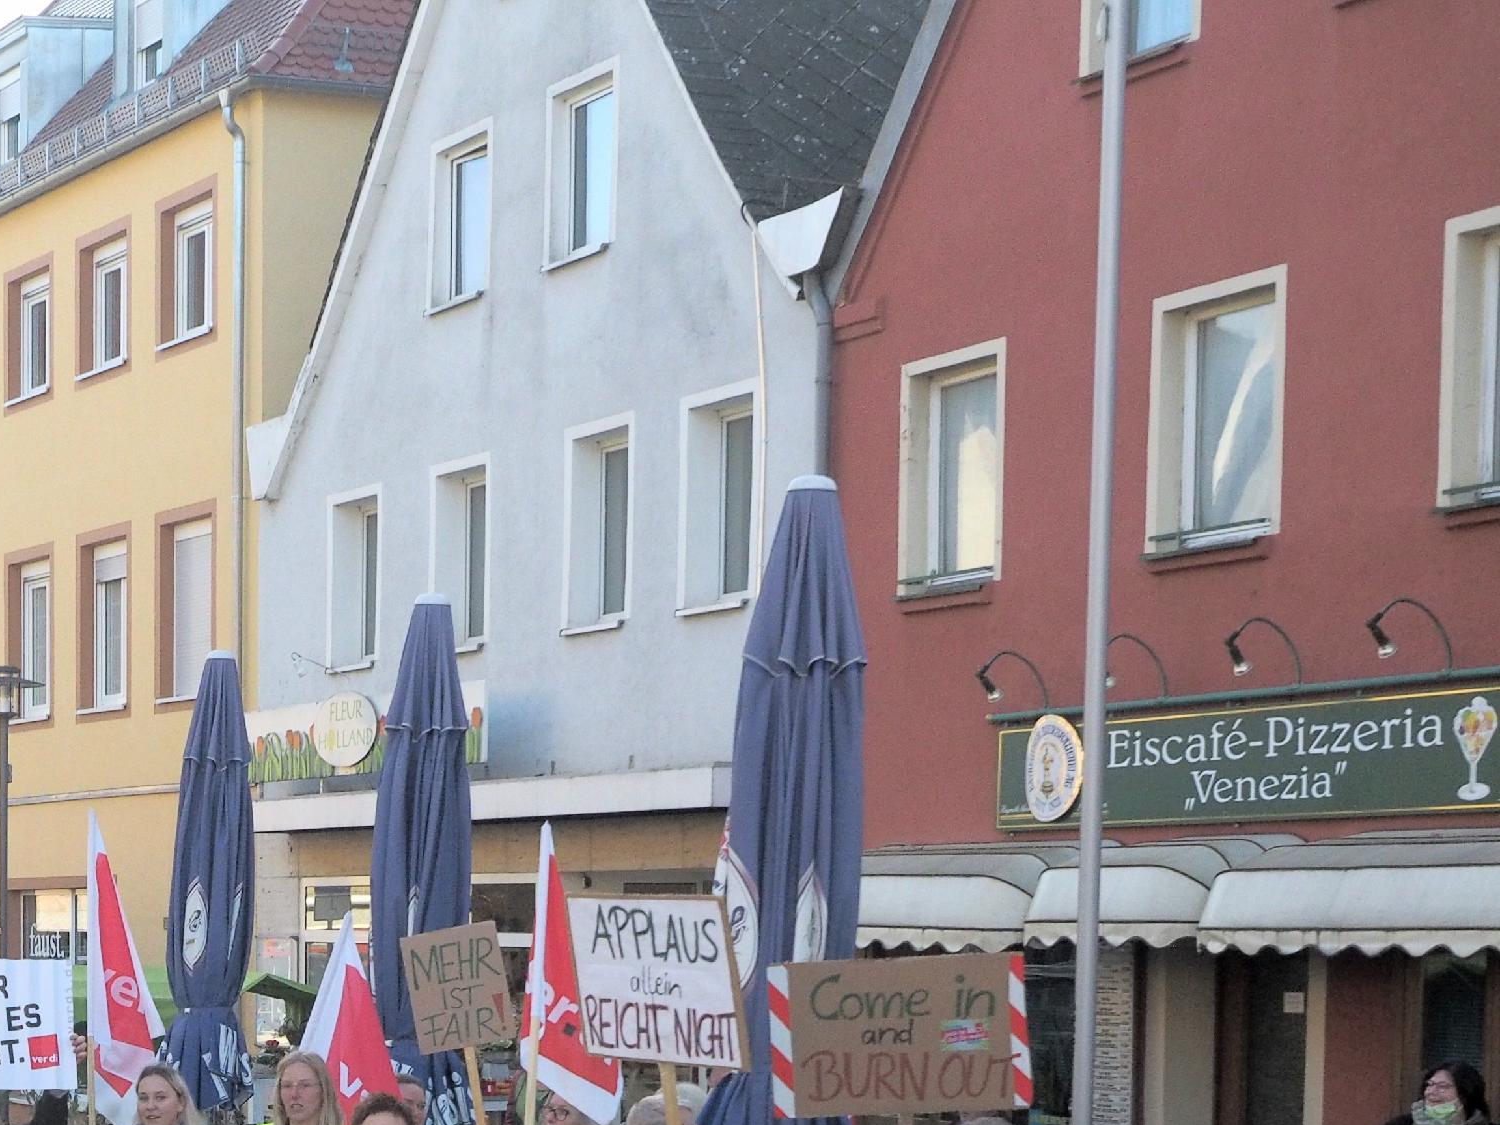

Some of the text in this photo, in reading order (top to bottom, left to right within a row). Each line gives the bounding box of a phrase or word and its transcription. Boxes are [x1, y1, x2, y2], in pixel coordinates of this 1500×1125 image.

[329, 700, 363, 721] FLEUR
[1106, 708, 1444, 769] Eiscafé-Pizzeria
[591, 904, 718, 963] APPLAUS
[410, 937, 501, 990] MEHR
[630, 966, 683, 998] allein
[442, 984, 485, 1010] IST
[809, 974, 997, 1021] Come in
[6, 1004, 42, 1032] ES
[585, 995, 669, 1053] REICHT
[673, 1007, 736, 1062] NICHT
[861, 1019, 914, 1045] and
